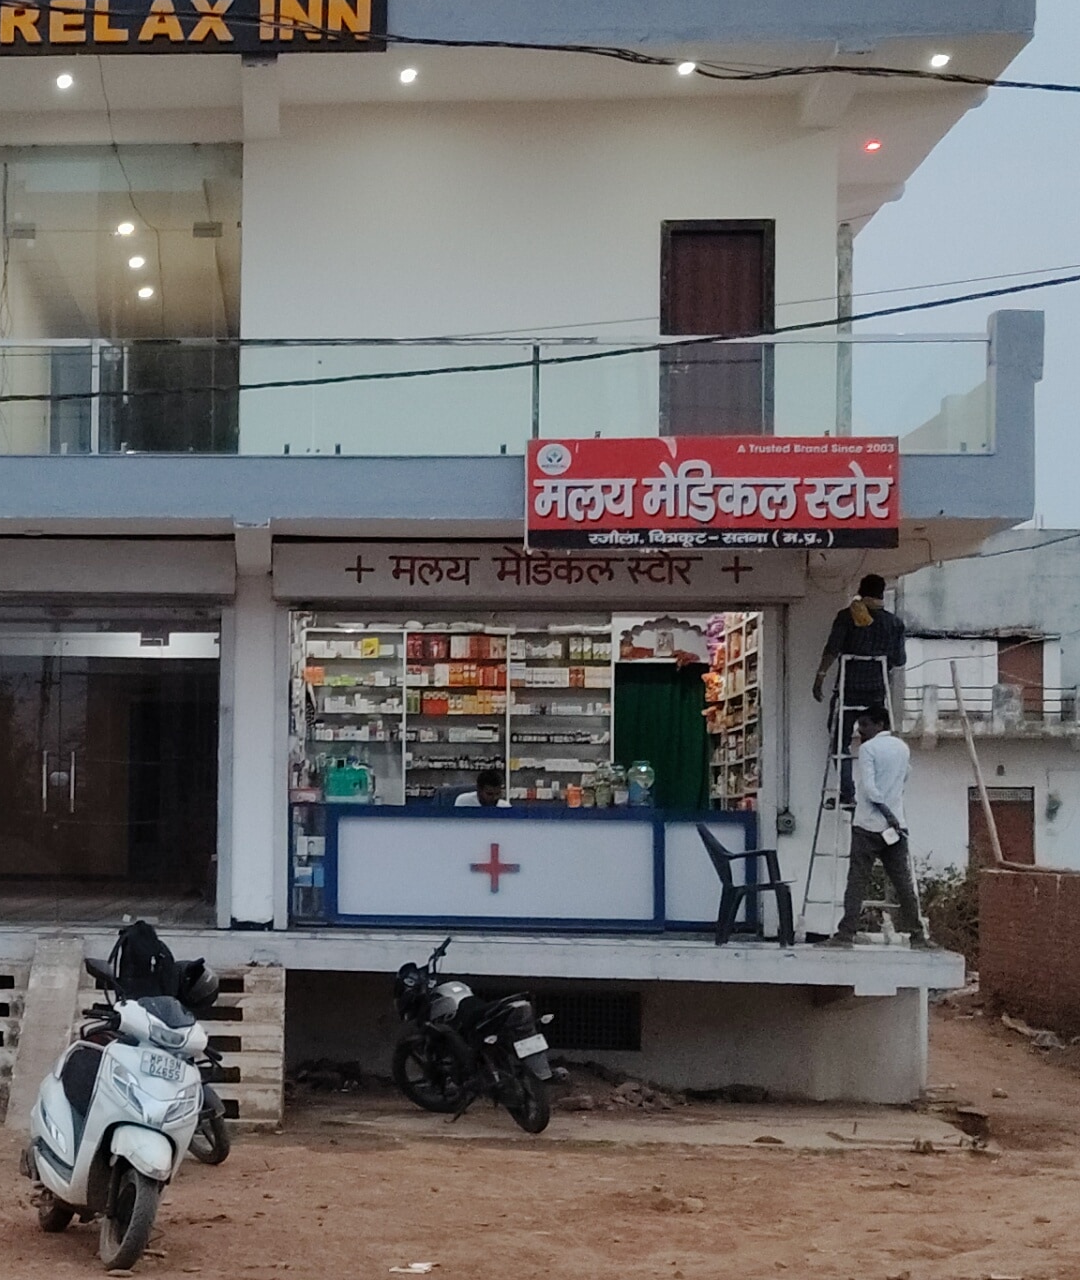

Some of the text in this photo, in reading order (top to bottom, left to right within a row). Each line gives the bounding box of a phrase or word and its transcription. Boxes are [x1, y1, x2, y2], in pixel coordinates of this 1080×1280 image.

[736, 444, 746, 454] A
[749, 444, 791, 454] Trusted
[793, 444, 828, 454] Brand
[831, 444, 863, 454] Since
[533, 458, 894, 522] मलय मेडिकल स्टोर
[389, 555, 480, 586] मलय
[627, 549, 704, 586] स्टोर
